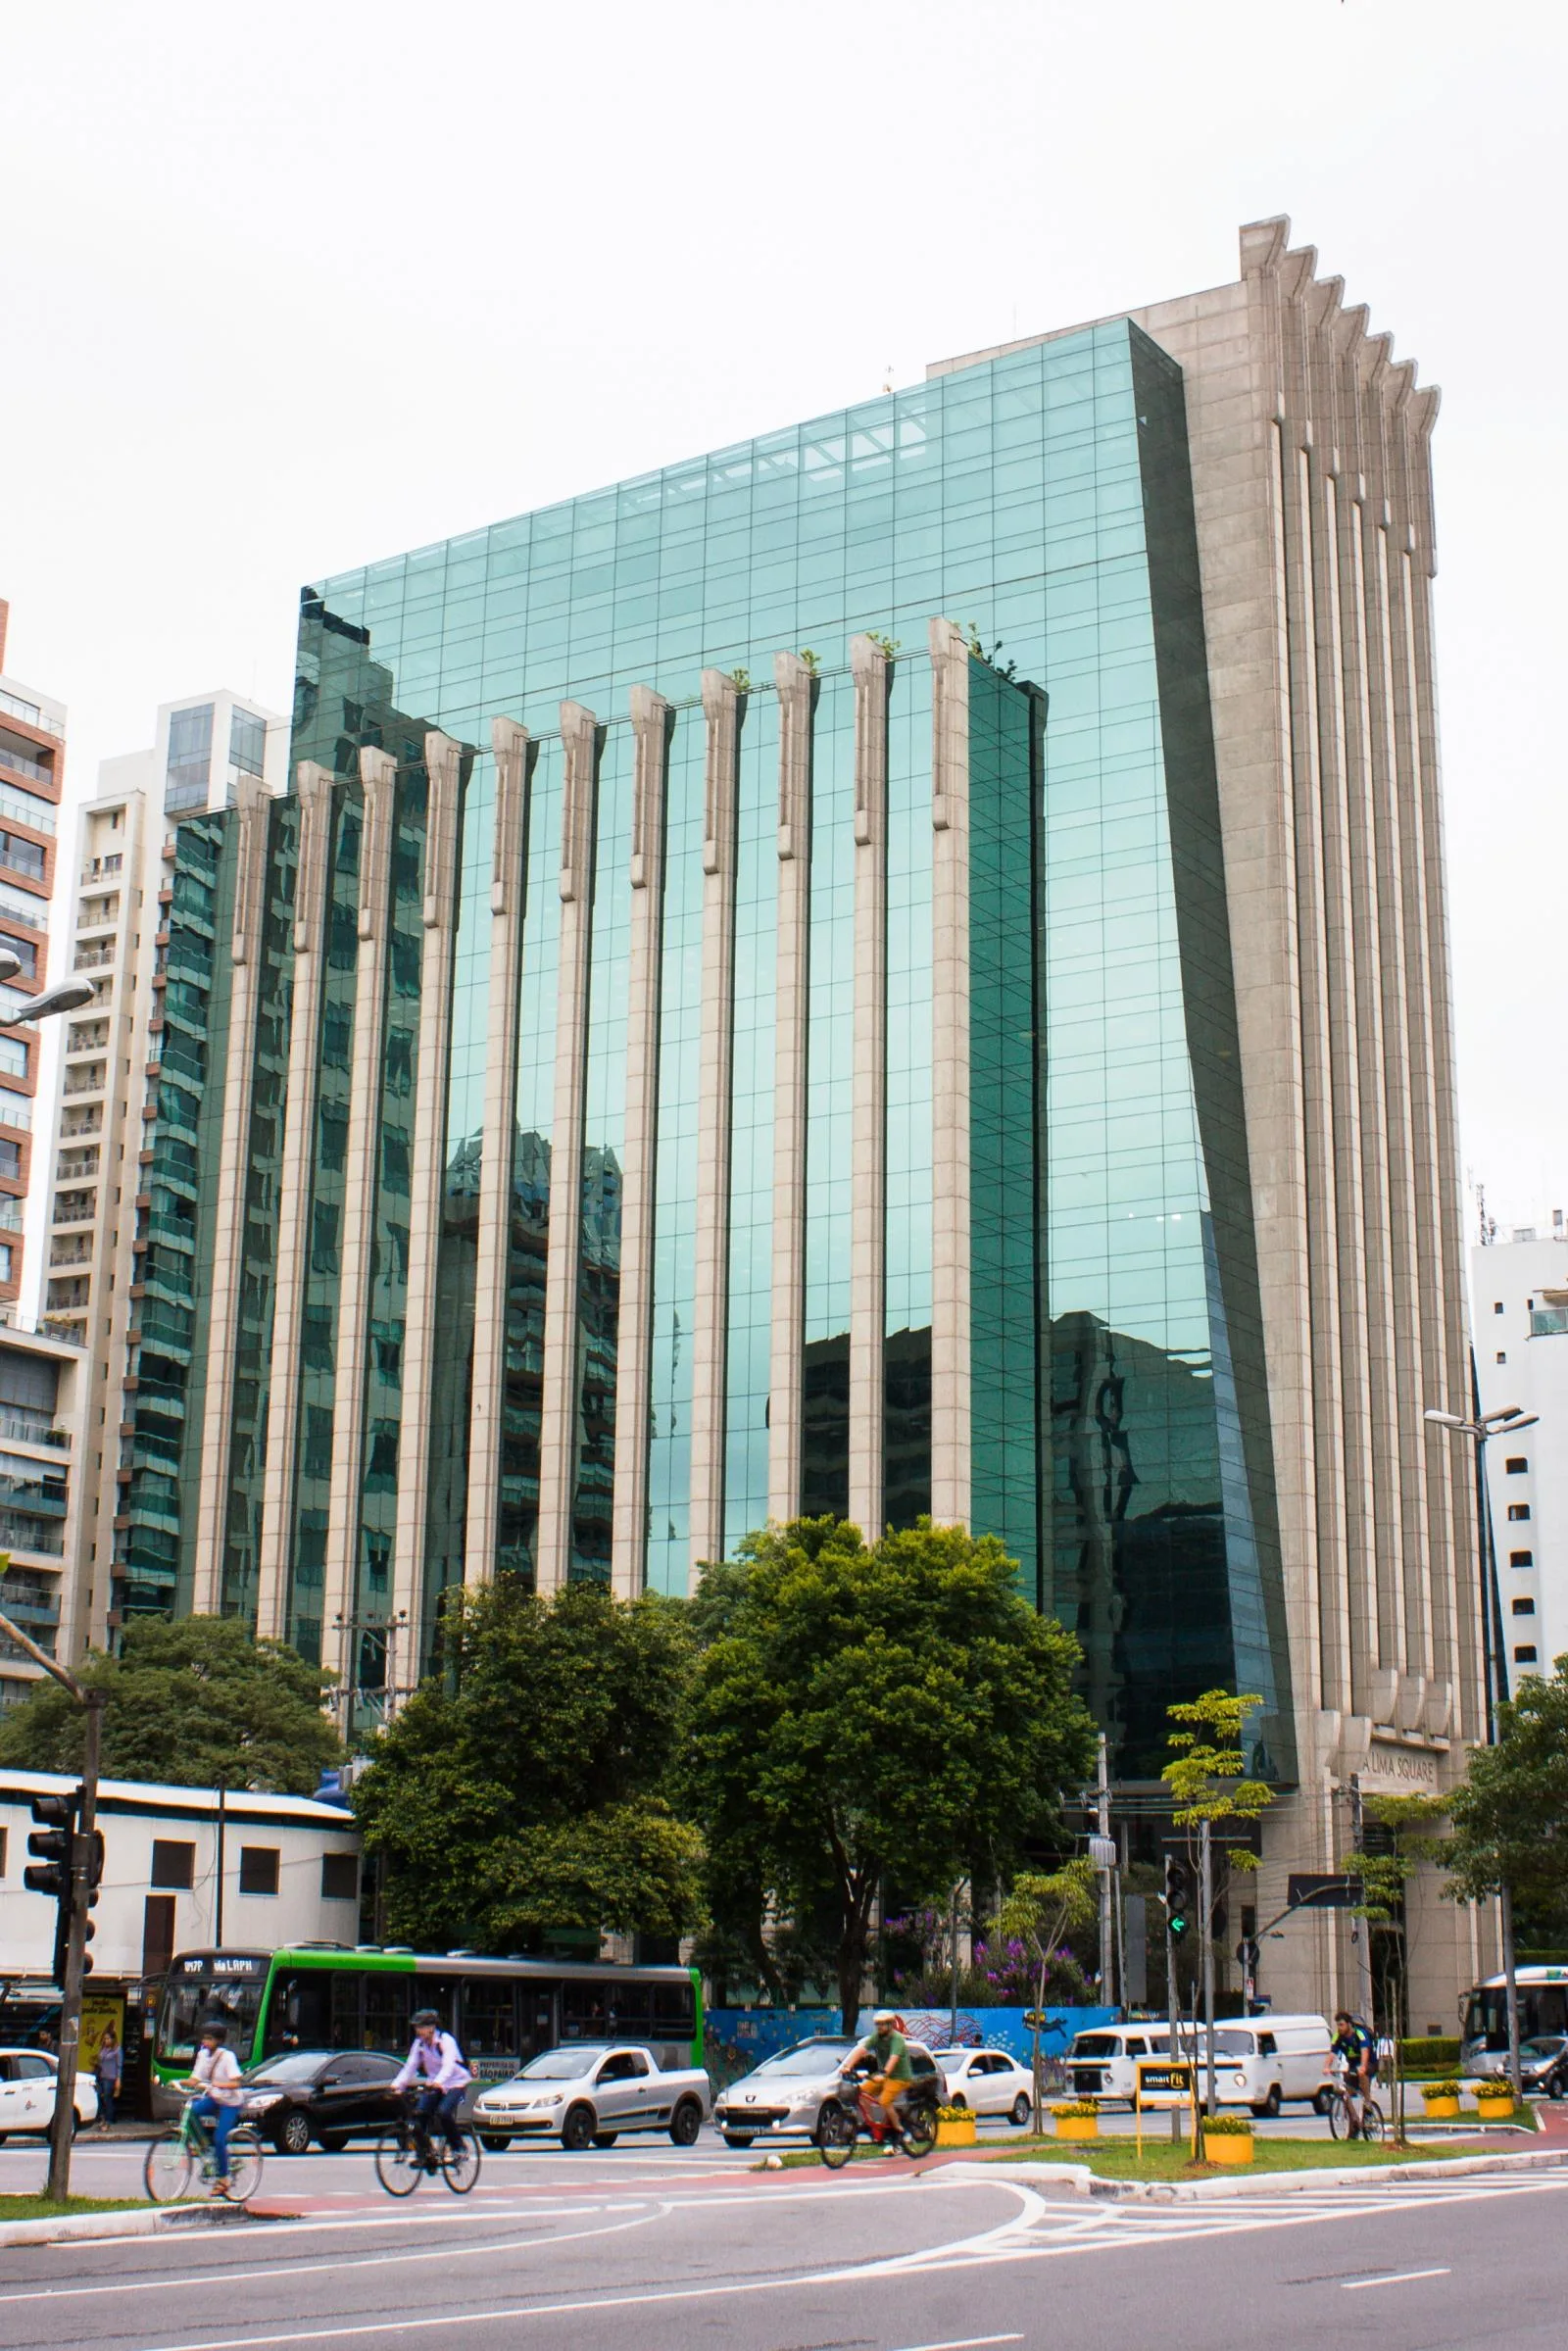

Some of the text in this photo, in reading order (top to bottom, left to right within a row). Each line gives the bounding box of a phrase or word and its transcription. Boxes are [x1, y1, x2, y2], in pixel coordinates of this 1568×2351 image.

[1372, 1751, 1396, 1778] LIMA
[1397, 1756, 1434, 1783] SQUARE
[1145, 2072, 1185, 2086] smart fit
